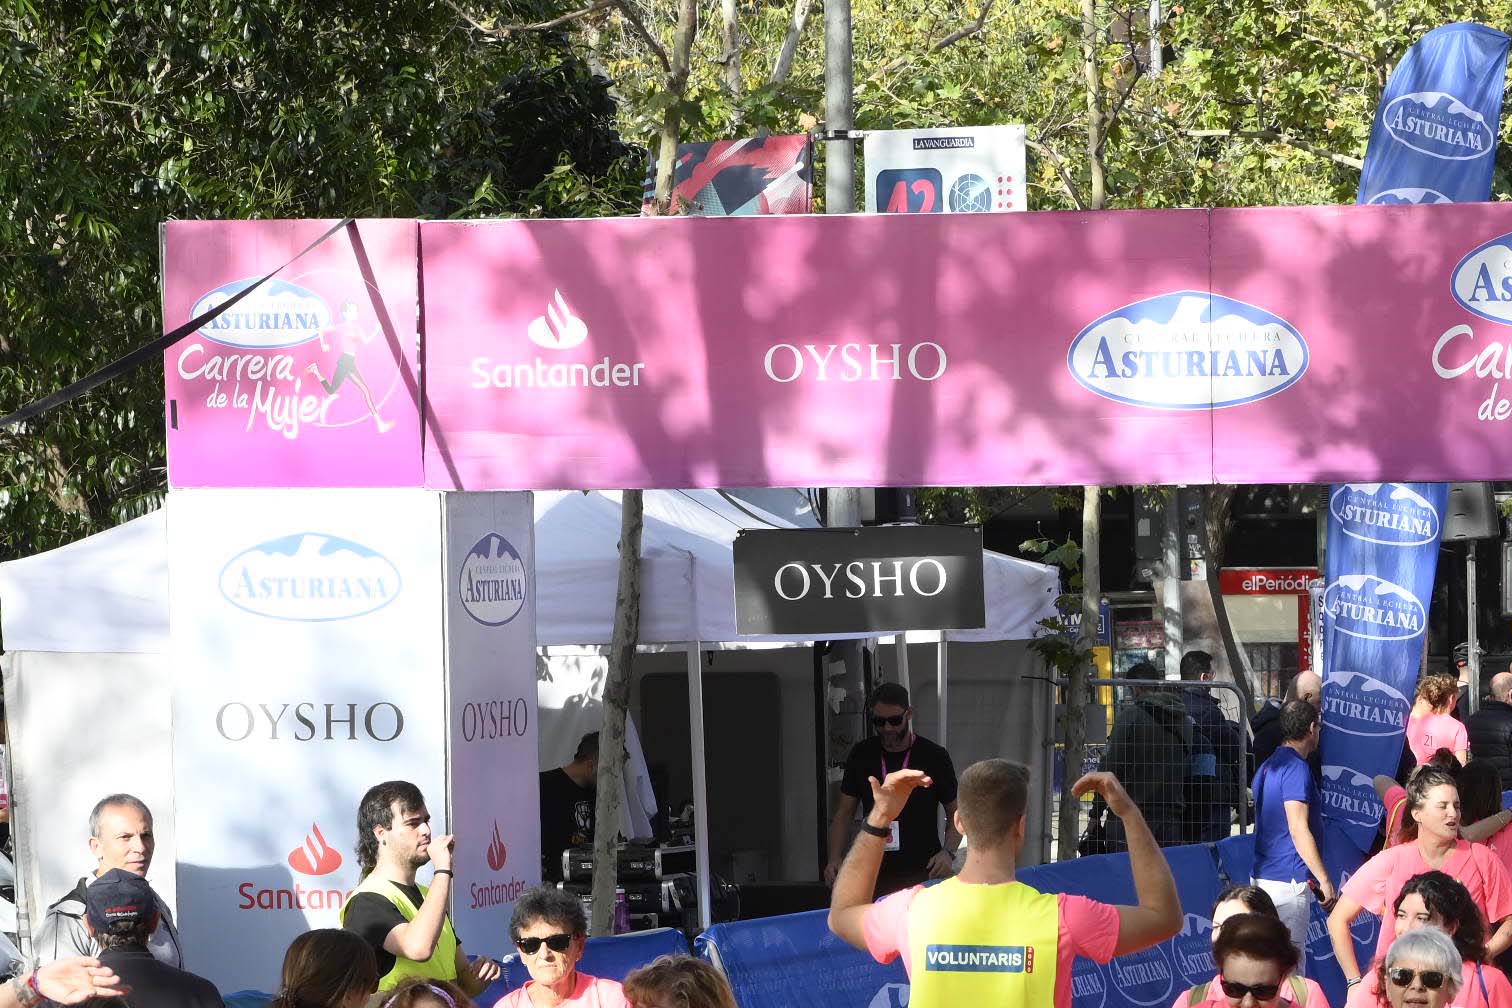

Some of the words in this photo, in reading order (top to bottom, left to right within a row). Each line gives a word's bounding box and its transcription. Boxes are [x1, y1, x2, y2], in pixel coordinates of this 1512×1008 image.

[1389, 106, 1483, 151] ASTURIANA
[177, 344, 295, 380] Carrera
[471, 357, 645, 388] Santander
[763, 342, 948, 383] OYSHO
[1087, 336, 1291, 379] ASTURIANA
[206, 384, 227, 409] de
[232, 382, 249, 409] la
[246, 377, 341, 440] Mujer
[1477, 382, 1512, 422] de
[1347, 494, 1389, 509] CENTRAL
[233, 566, 388, 600] ASTURIANA
[465, 568, 523, 603] ASTURIANA
[773, 558, 948, 600] OYSHO
[215, 701, 405, 742] OYSHO
[461, 697, 528, 743] OYSHO
[470, 879, 525, 909] Santander
[926, 950, 1022, 968] VOLUNTARIS
[1113, 955, 1170, 988] ASTURIANA
